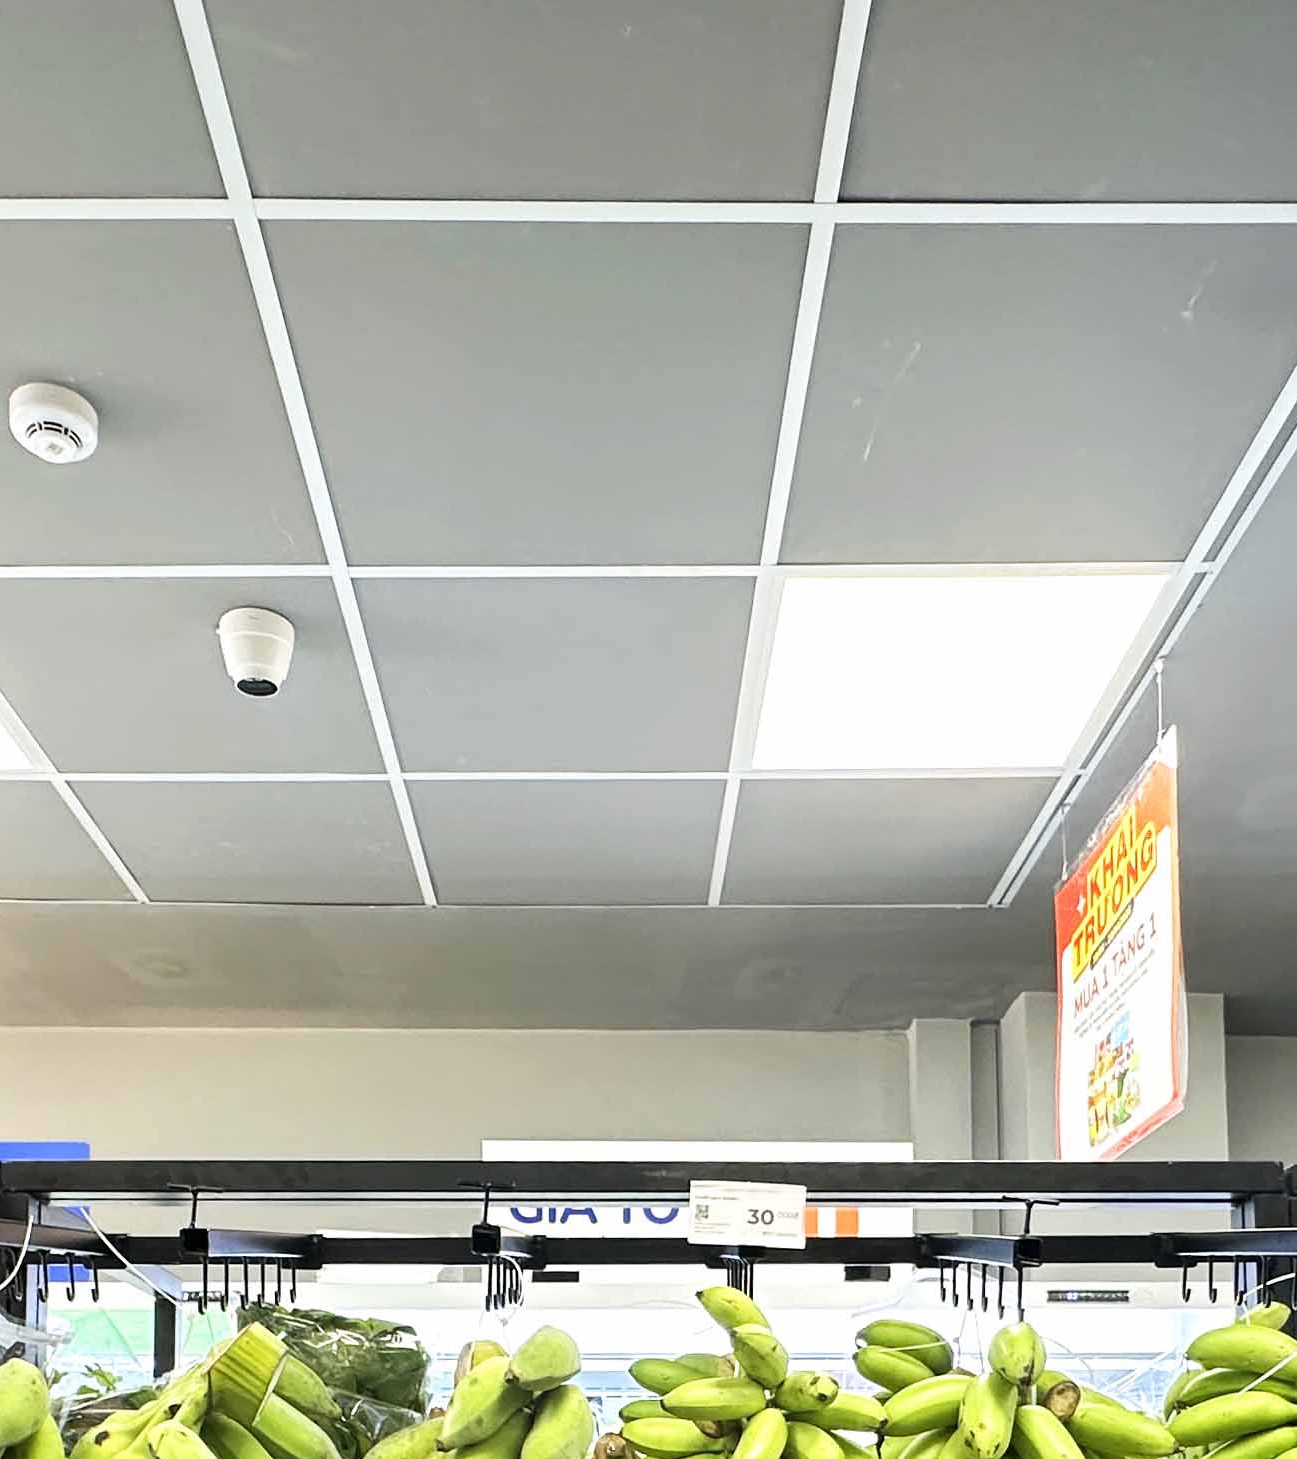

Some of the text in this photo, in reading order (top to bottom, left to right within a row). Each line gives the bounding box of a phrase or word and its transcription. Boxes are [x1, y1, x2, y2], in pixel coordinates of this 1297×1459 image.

[1089, 815, 1134, 908] KHAI
[1074, 975, 1100, 1019] MUA
[746, 1208, 774, 1225] 30
